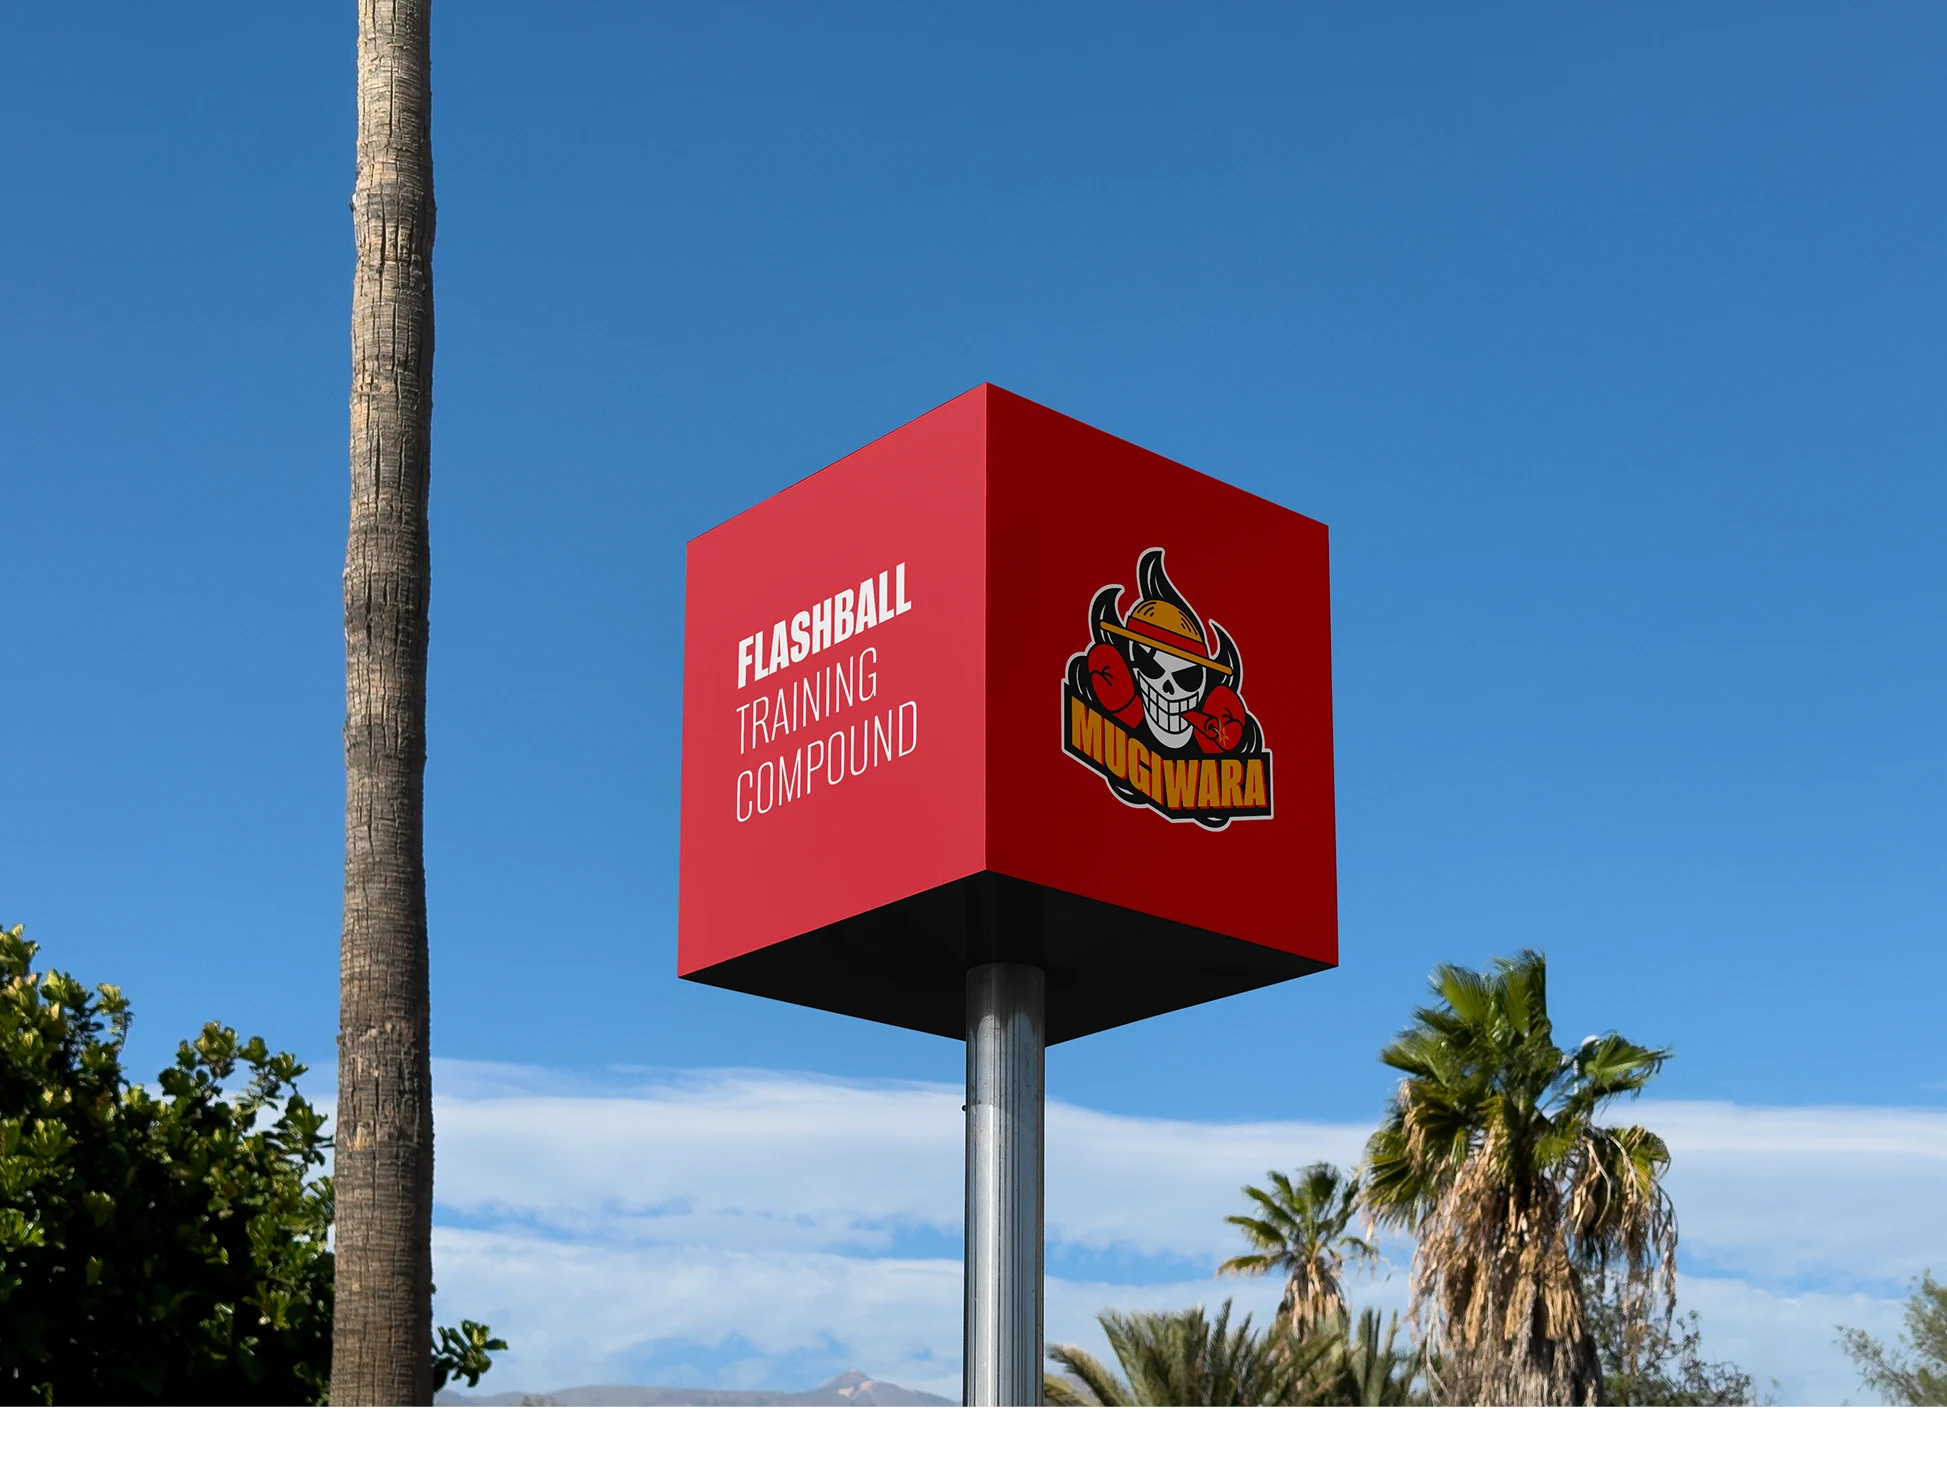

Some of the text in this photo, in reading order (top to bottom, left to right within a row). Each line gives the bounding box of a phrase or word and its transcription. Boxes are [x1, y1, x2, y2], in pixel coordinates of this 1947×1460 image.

[737, 562, 912, 690] FLASHBALL
[736, 647, 877, 755] TRAINING
[1071, 695, 1268, 810] MUGIWARA
[736, 700, 918, 823] COMPOUND
